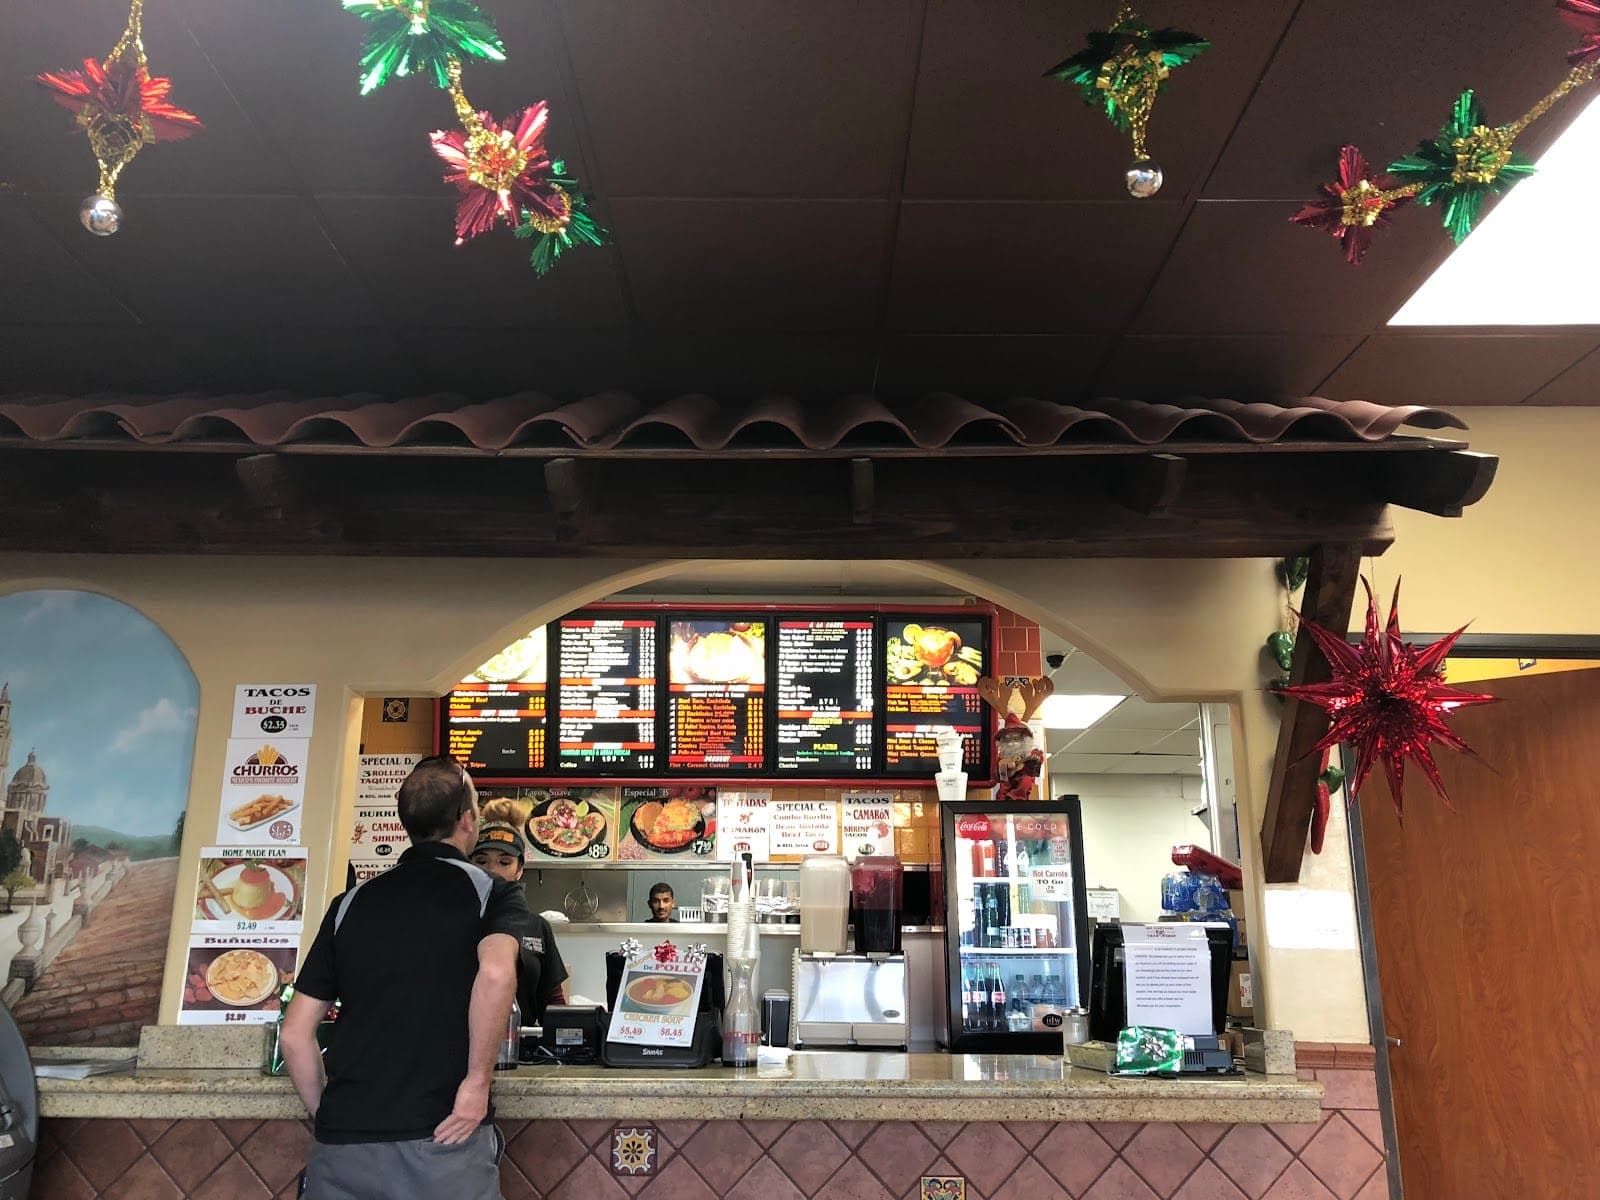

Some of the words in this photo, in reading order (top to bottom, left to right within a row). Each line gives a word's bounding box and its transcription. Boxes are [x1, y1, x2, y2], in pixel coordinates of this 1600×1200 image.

[244, 687, 310, 697] TACOS
[245, 706, 306, 714] BUCHE
[263, 720, 285, 729] $2.35
[361, 757, 402, 766] SPECIAL
[404, 757, 414, 766] D.
[233, 765, 298, 776] CHURROS
[624, 788, 656, 798] Especial
[845, 797, 889, 805] TACOS
[776, 803, 815, 812] SPECIAL
[818, 802, 828, 812] C.
[960, 822, 988, 832] Coca-Cola
[222, 849, 245, 857] HOME
[248, 849, 266, 857] MADE
[268, 849, 287, 857] FLAN
[204, 936, 289, 944] Buñuelos
[655, 963, 702, 974] POLLO
